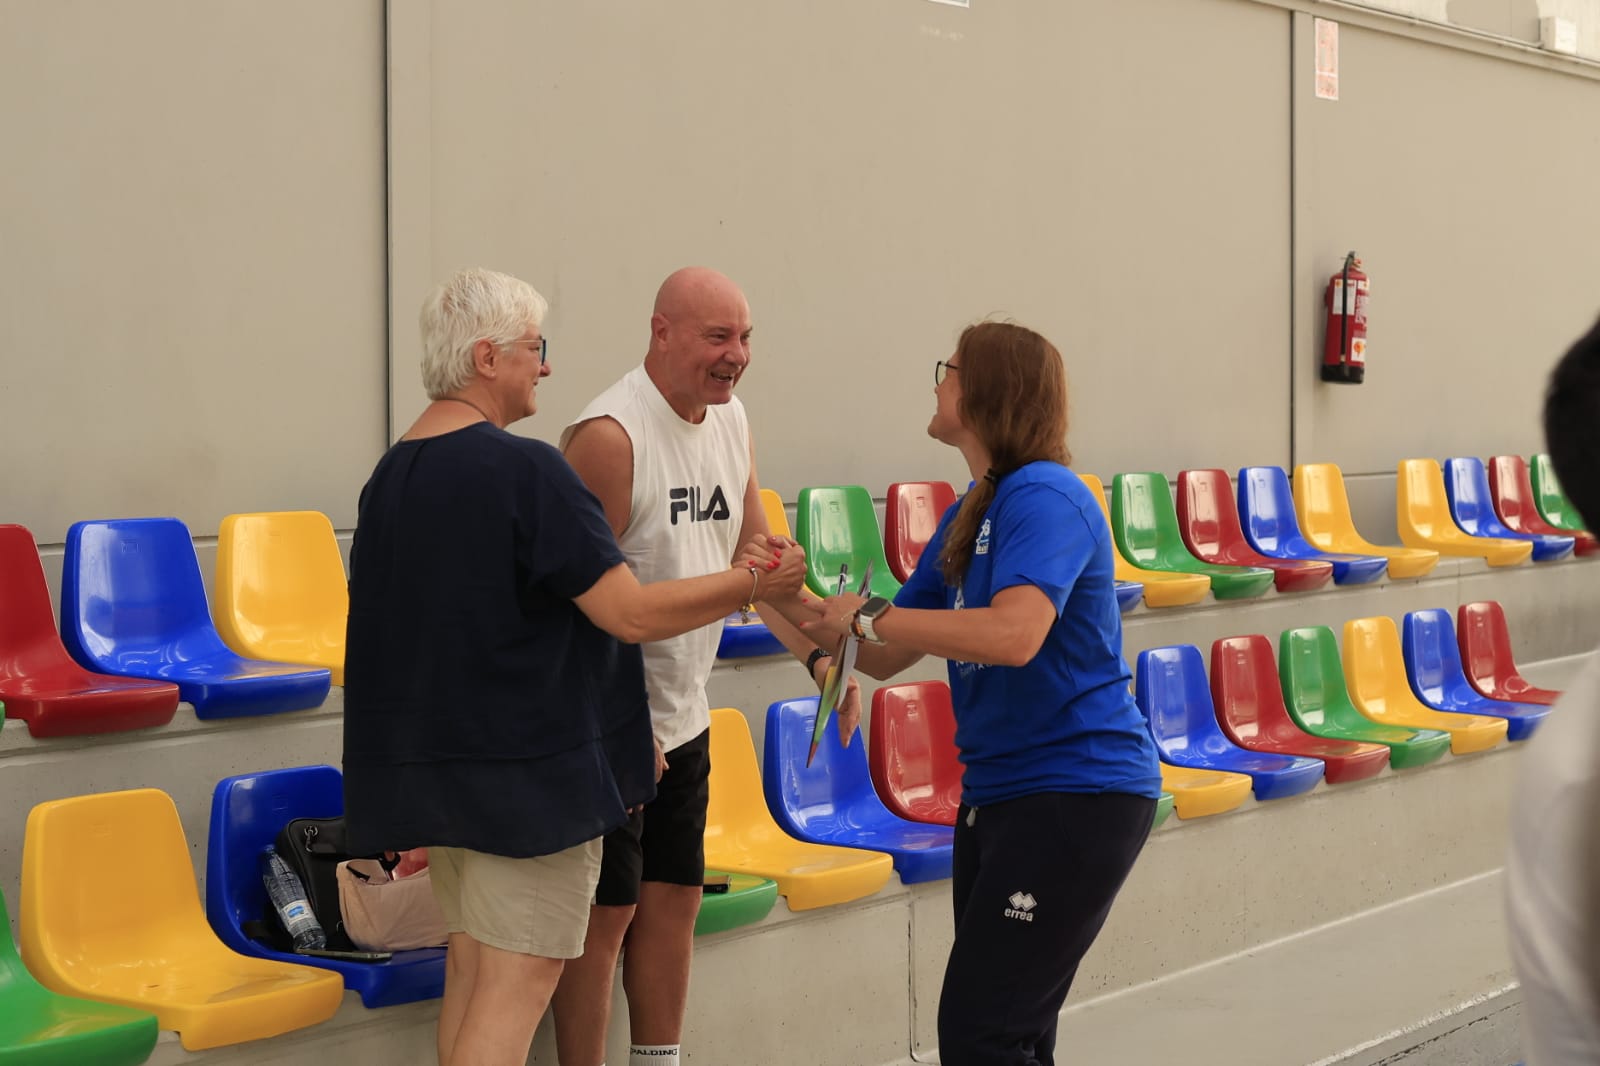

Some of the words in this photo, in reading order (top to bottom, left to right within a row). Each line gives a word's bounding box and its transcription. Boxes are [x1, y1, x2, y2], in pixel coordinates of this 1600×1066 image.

[670, 484, 730, 525] FILA
[1004, 908, 1034, 922] errea
[630, 1047, 678, 1056] PALDING
